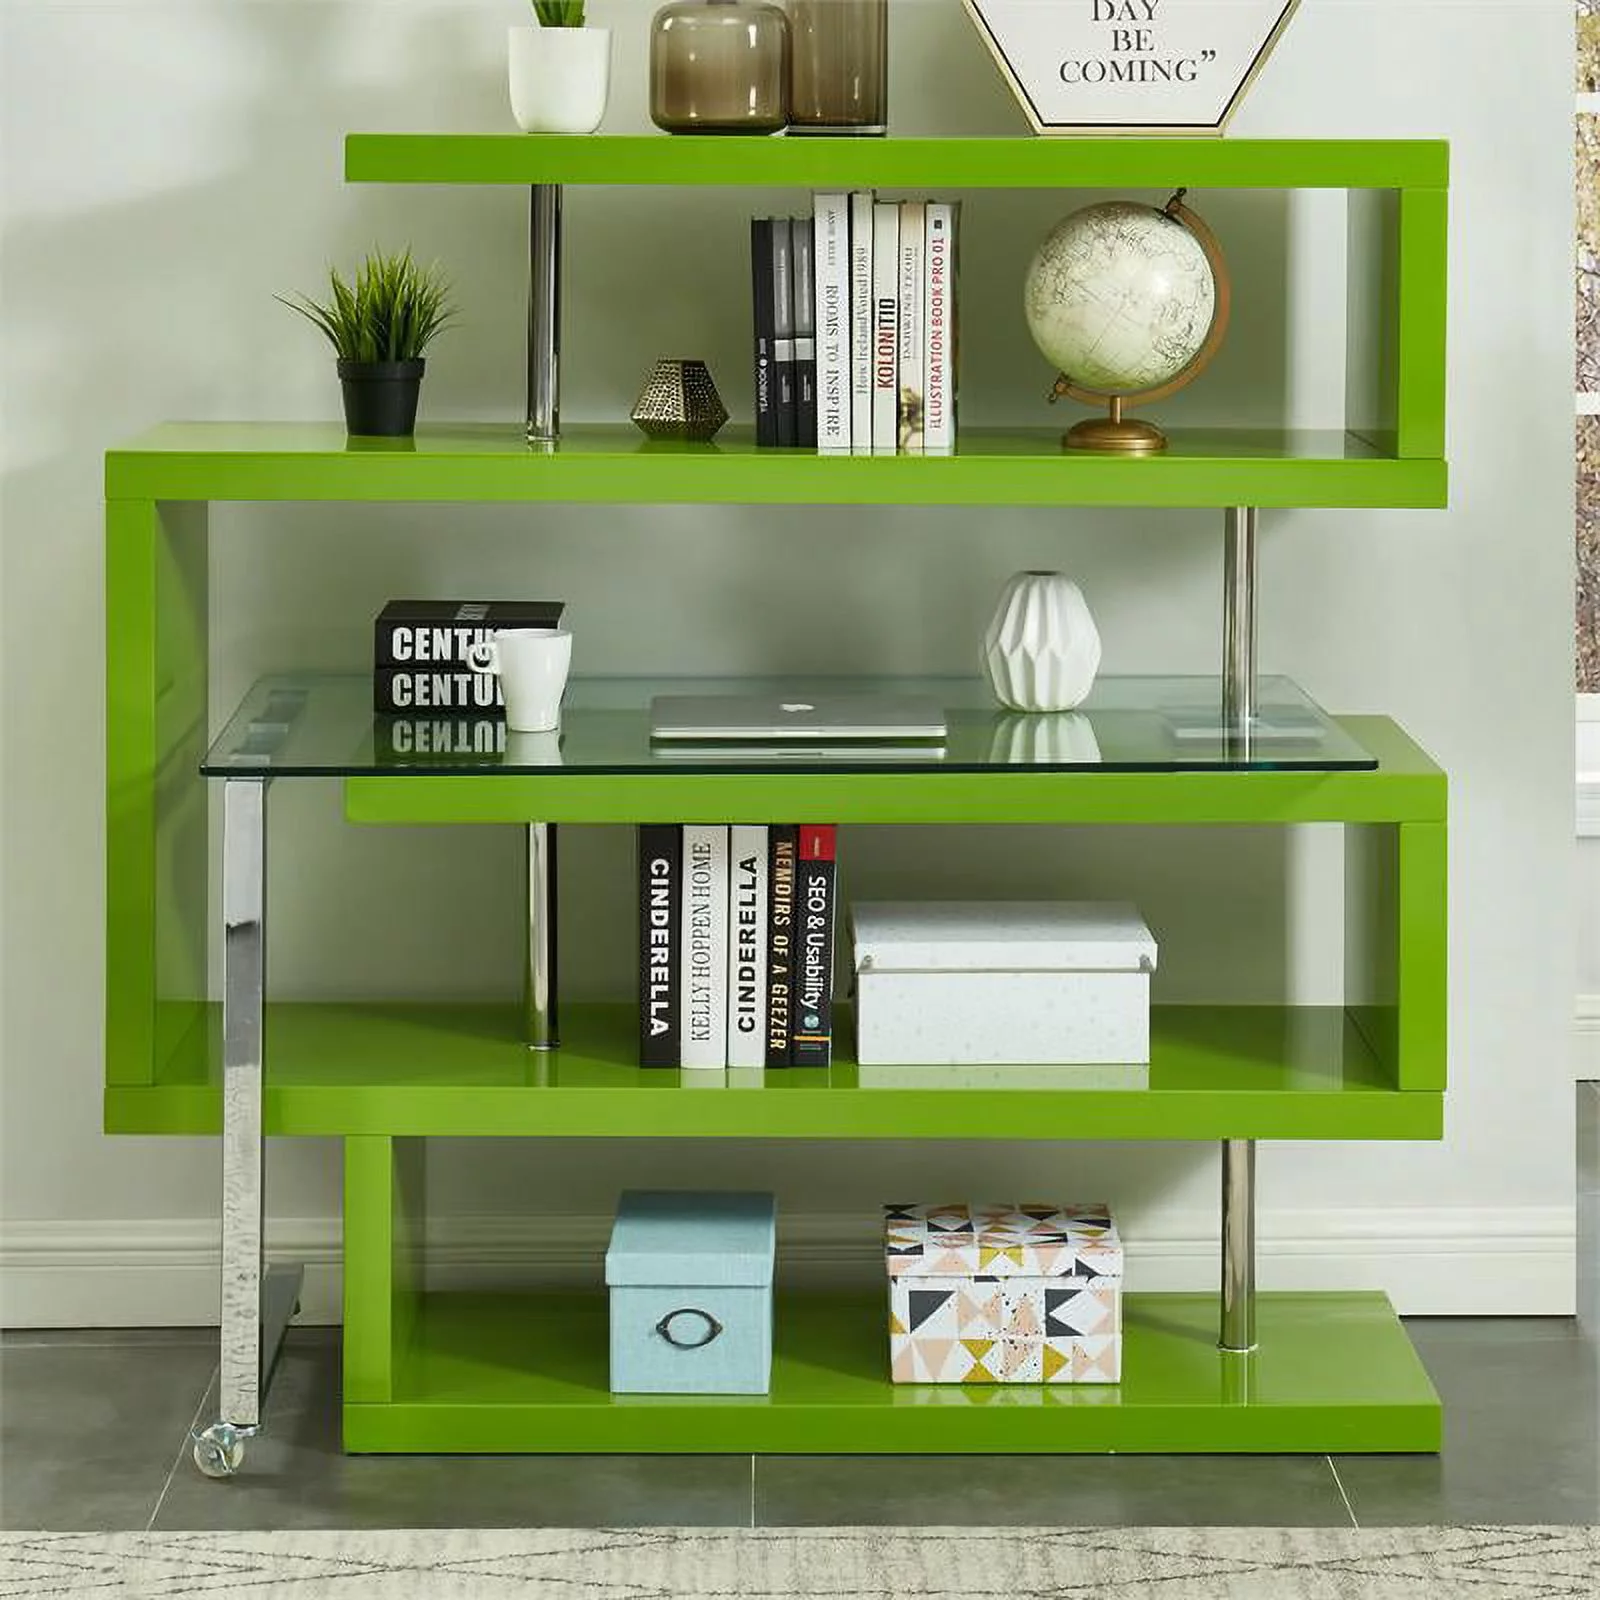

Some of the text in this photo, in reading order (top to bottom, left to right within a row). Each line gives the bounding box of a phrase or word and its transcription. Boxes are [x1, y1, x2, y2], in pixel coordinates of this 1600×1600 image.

[1091, 0, 1159, 21] DAY
[1112, 29, 1155, 52] BE
[826, 285, 840, 436] ROOMS TO INSPIRE
[929, 238, 944, 428] ILLUSTRATION BOOK PRO 01
[392, 627, 497, 661] CENTU
[650, 858, 670, 1036] CINDERELLA
[691, 843, 711, 1041] KELLY HOPPEN HOME
[738, 856, 757, 1033] CINDERELLA
[770, 841, 793, 1050] MEMOIRS OF A GEEZER
[800, 876, 827, 1010] SEO & Usability
